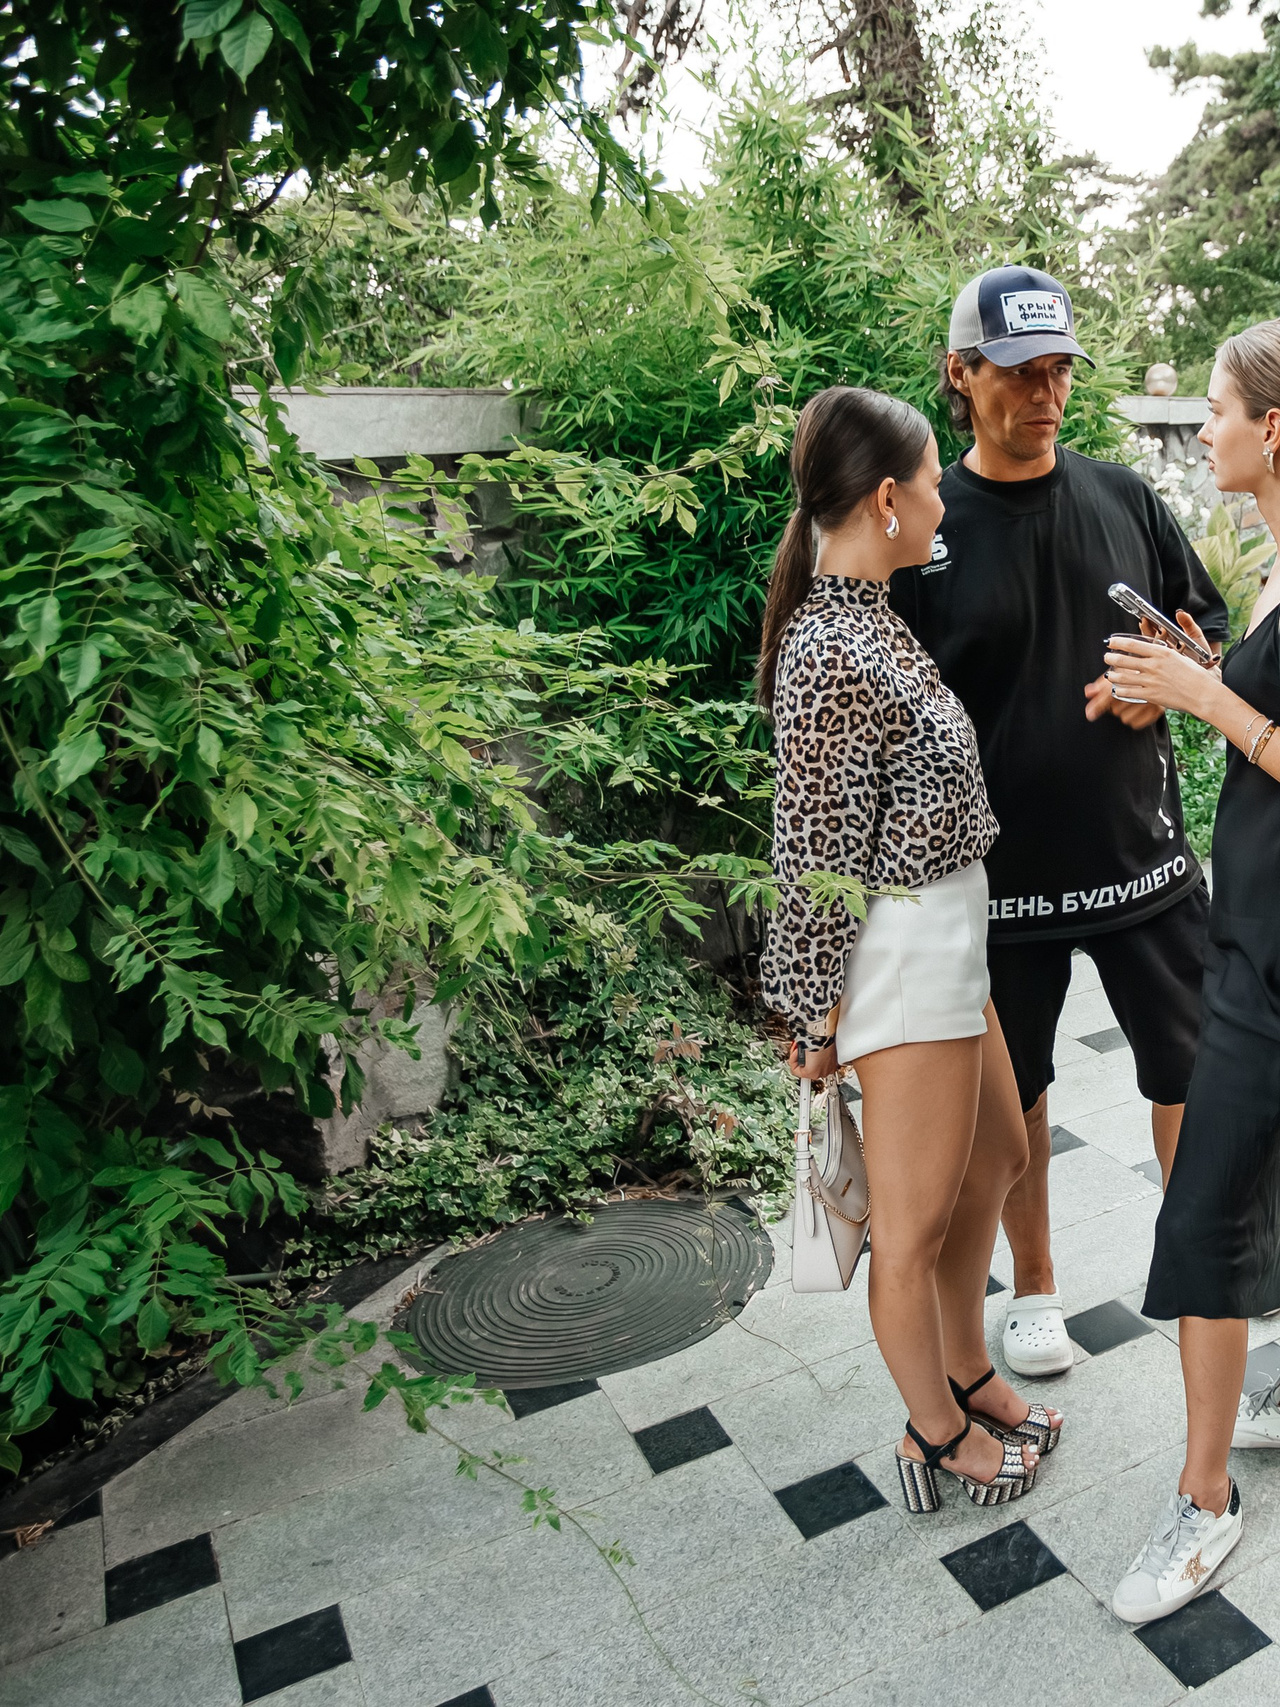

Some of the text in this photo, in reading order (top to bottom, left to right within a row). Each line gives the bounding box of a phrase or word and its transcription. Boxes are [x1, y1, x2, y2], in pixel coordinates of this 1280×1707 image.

[1018, 303, 1055, 312] КРЫМ
[1020, 311, 1057, 322] фильм
[1062, 855, 1186, 913] БУДУЩЕГО
